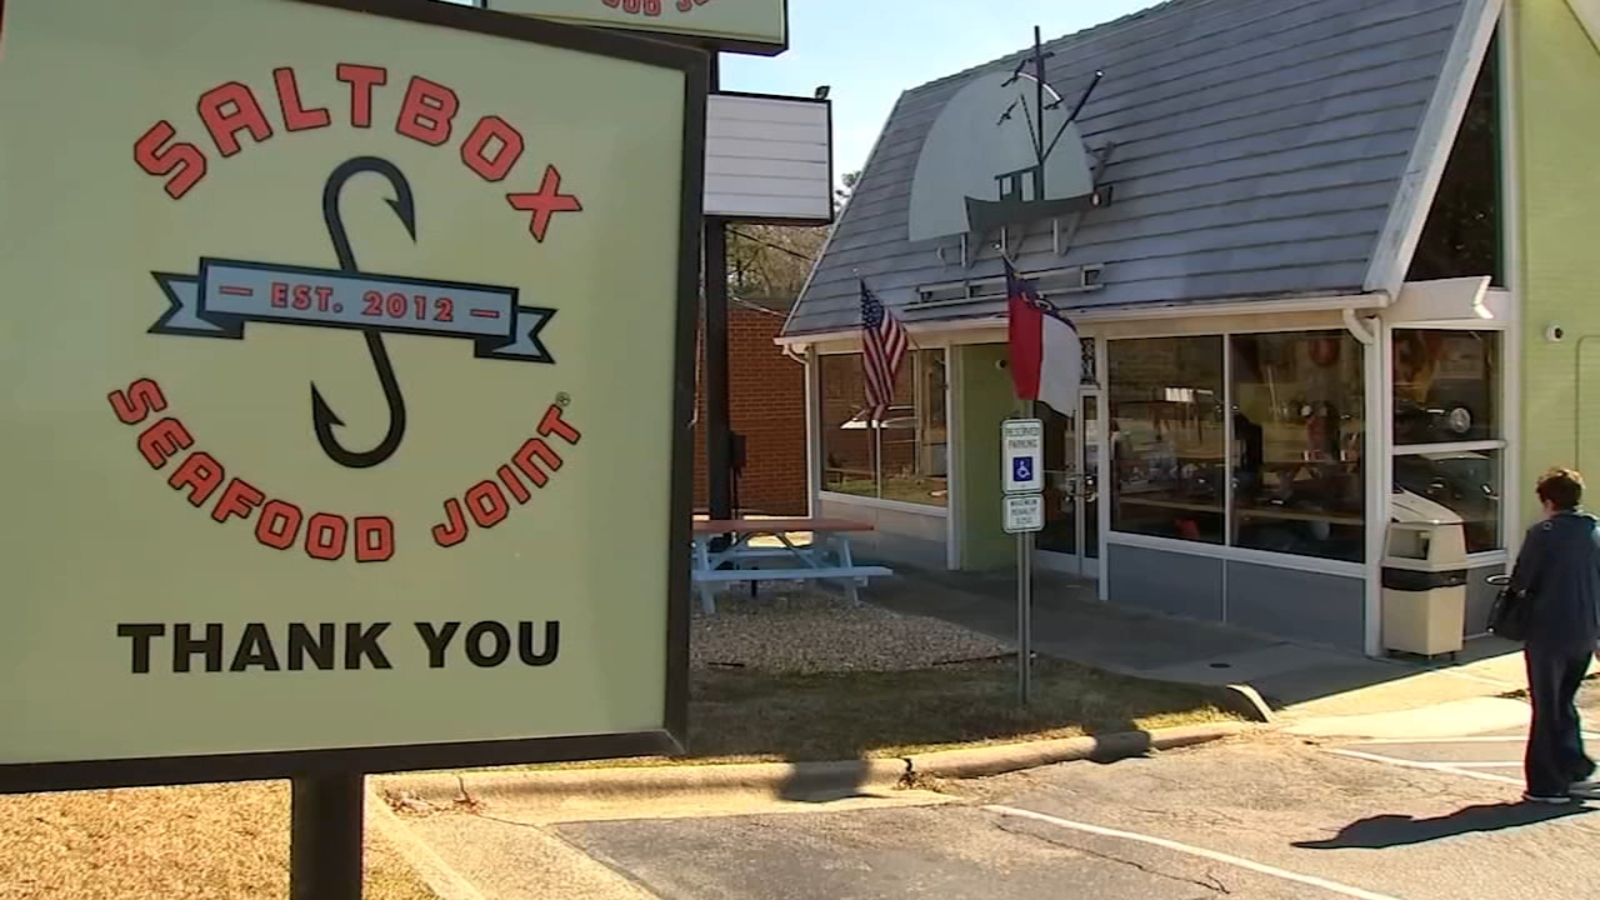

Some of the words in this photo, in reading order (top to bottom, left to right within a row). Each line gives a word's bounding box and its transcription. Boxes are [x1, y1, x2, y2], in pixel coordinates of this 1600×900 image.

[133, 63, 582, 243] SALTBOX
[270, 282, 343, 314] EST.
[363, 290, 455, 323] 2012
[107, 377, 395, 563] SEAFOOD
[431, 403, 582, 548] JOINT
[117, 622, 392, 674] THANK
[414, 620, 560, 669] YOU
